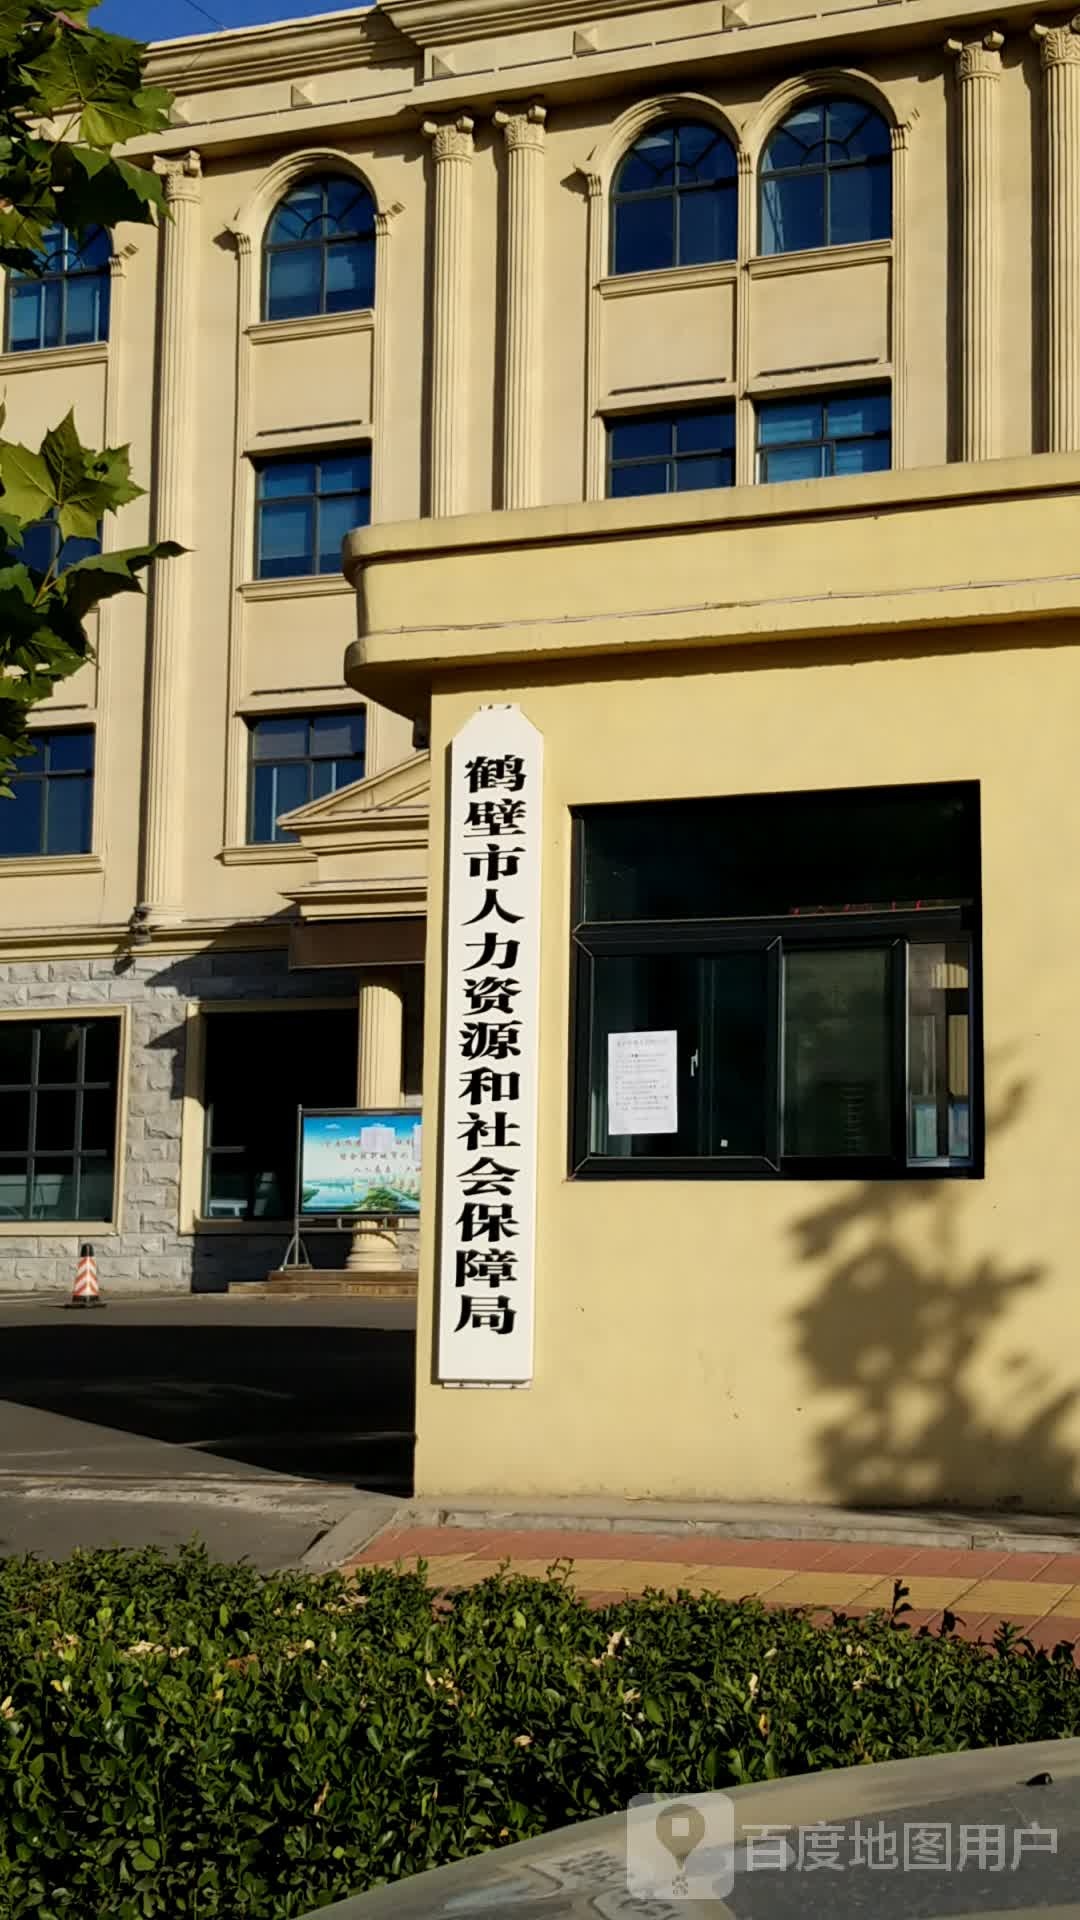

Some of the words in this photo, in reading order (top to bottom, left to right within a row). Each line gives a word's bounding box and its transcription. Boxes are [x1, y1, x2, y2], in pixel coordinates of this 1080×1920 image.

[454, 754, 527, 1335] 鹤壁市人力资源和社会保障局
